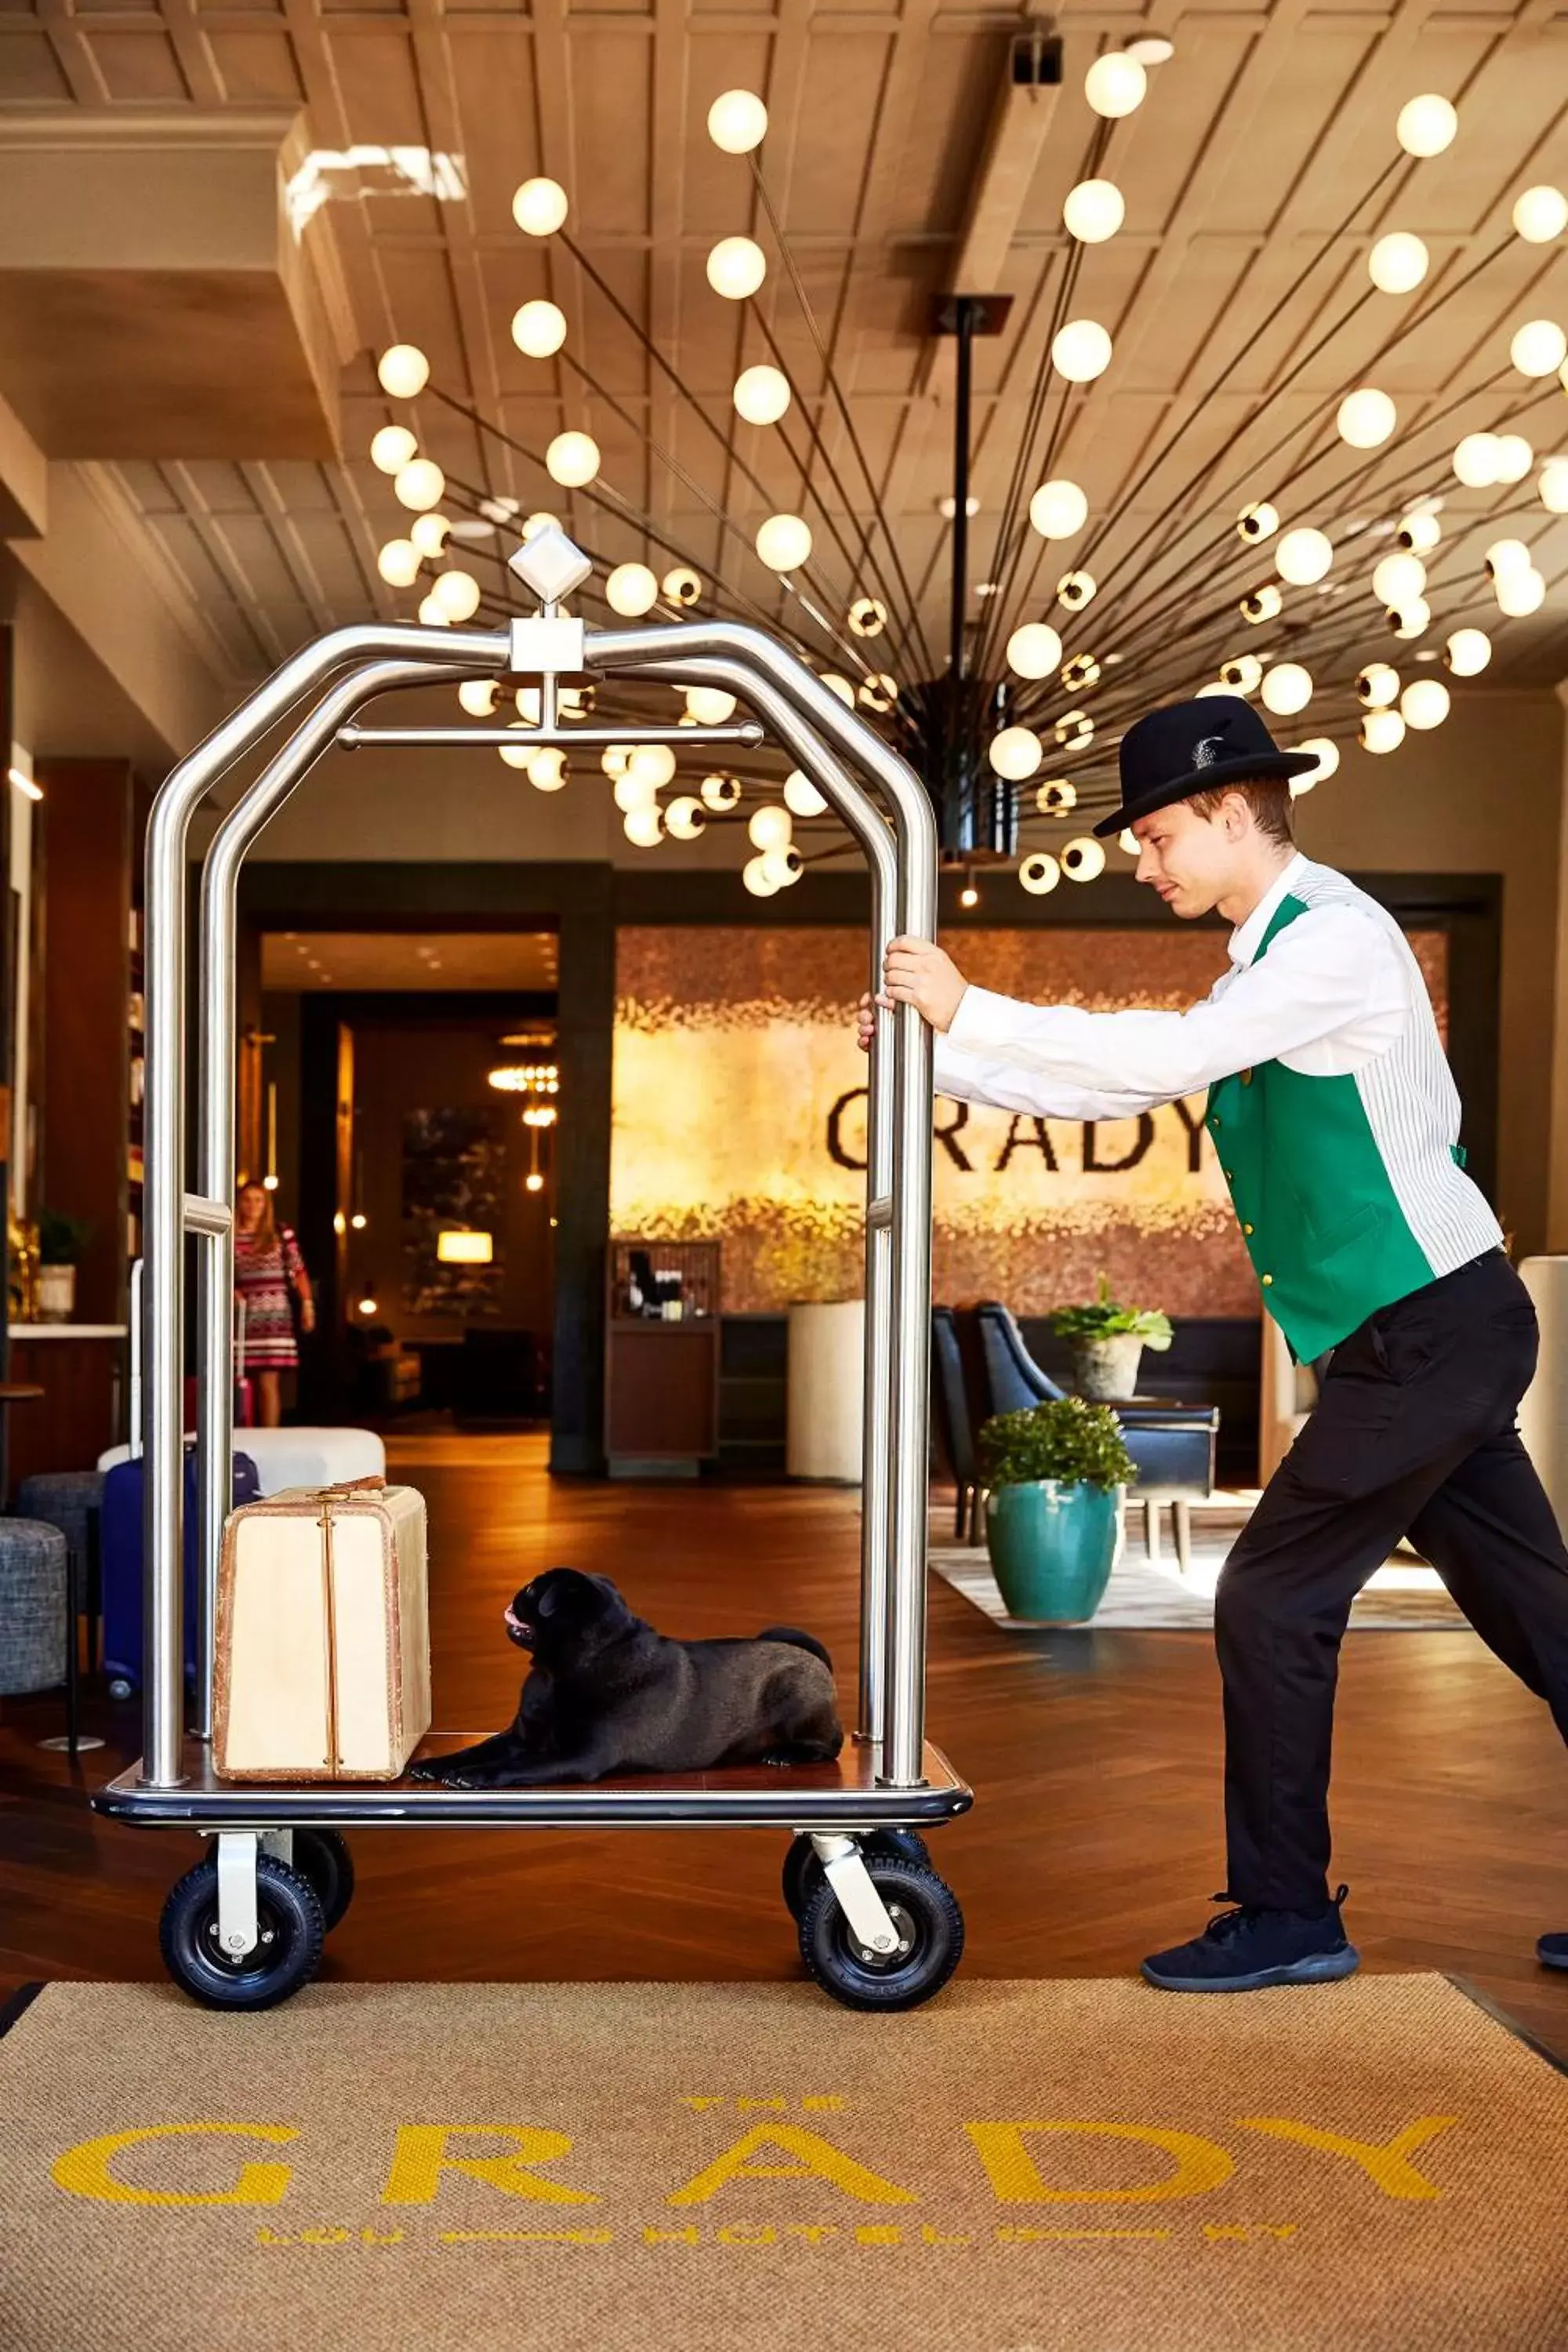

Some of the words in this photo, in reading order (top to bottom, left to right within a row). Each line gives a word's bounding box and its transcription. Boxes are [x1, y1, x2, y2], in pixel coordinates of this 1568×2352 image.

[677, 2094, 844, 2112] THE
[50, 2116, 1460, 2205] GRADY
[256, 2225, 404, 2245] LOU
[642, 2223, 971, 2245] HOTEL
